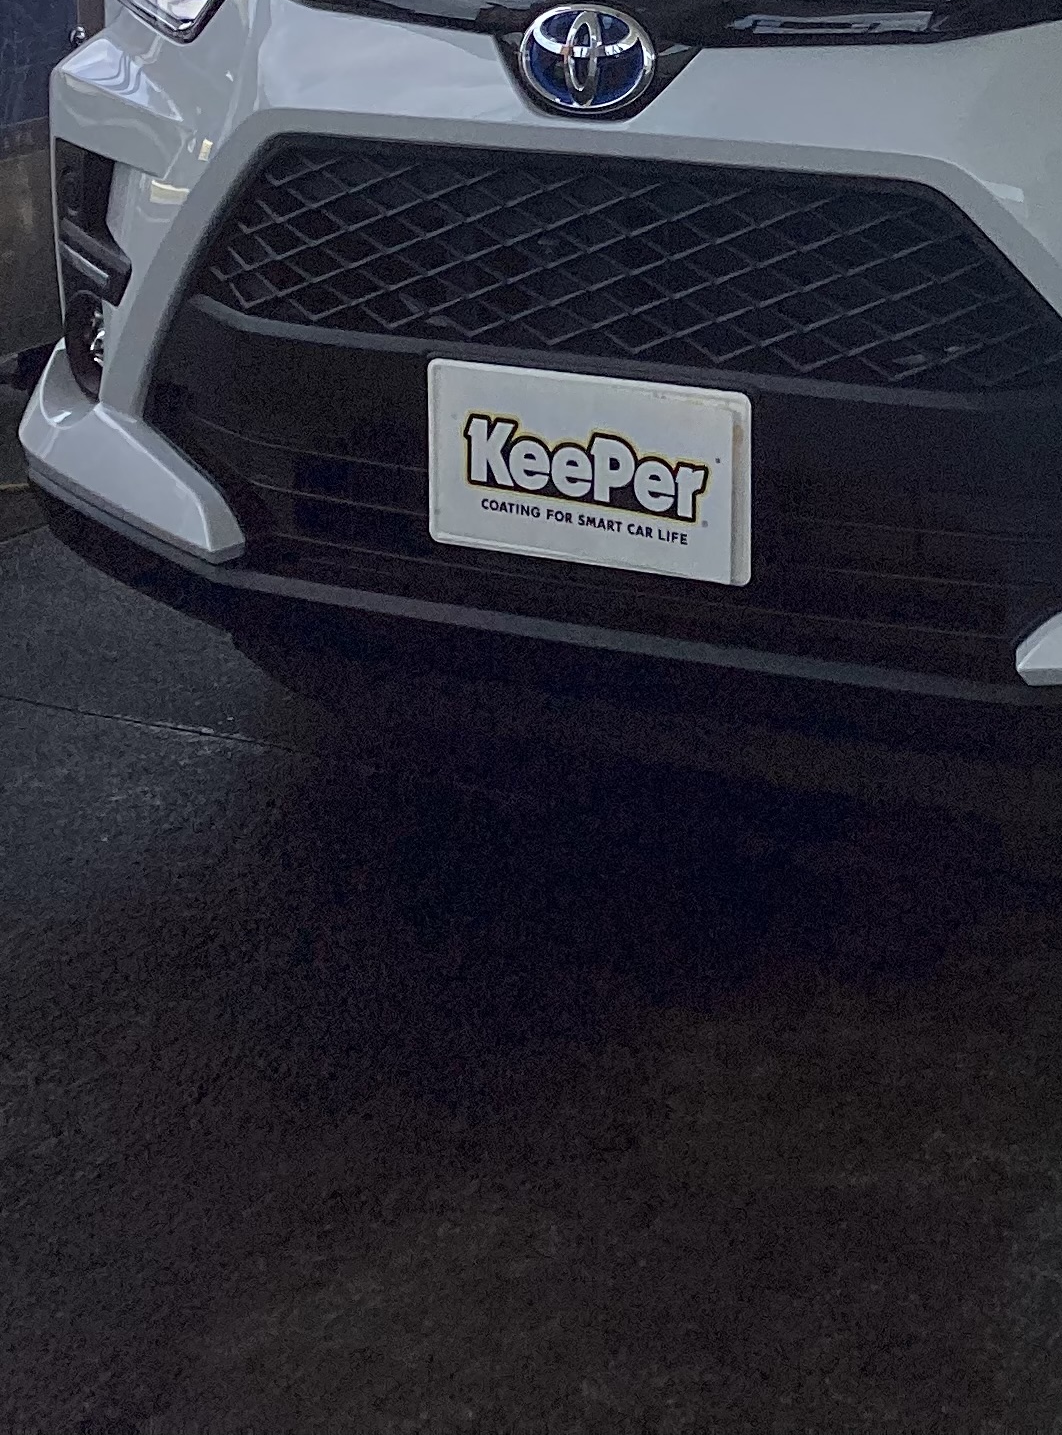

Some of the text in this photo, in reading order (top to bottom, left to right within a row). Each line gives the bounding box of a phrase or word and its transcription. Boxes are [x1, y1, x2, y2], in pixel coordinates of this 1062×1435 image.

[463, 413, 710, 524] KeePer
[481, 497, 689, 547] COATING FOR SMART CAR LIFE
